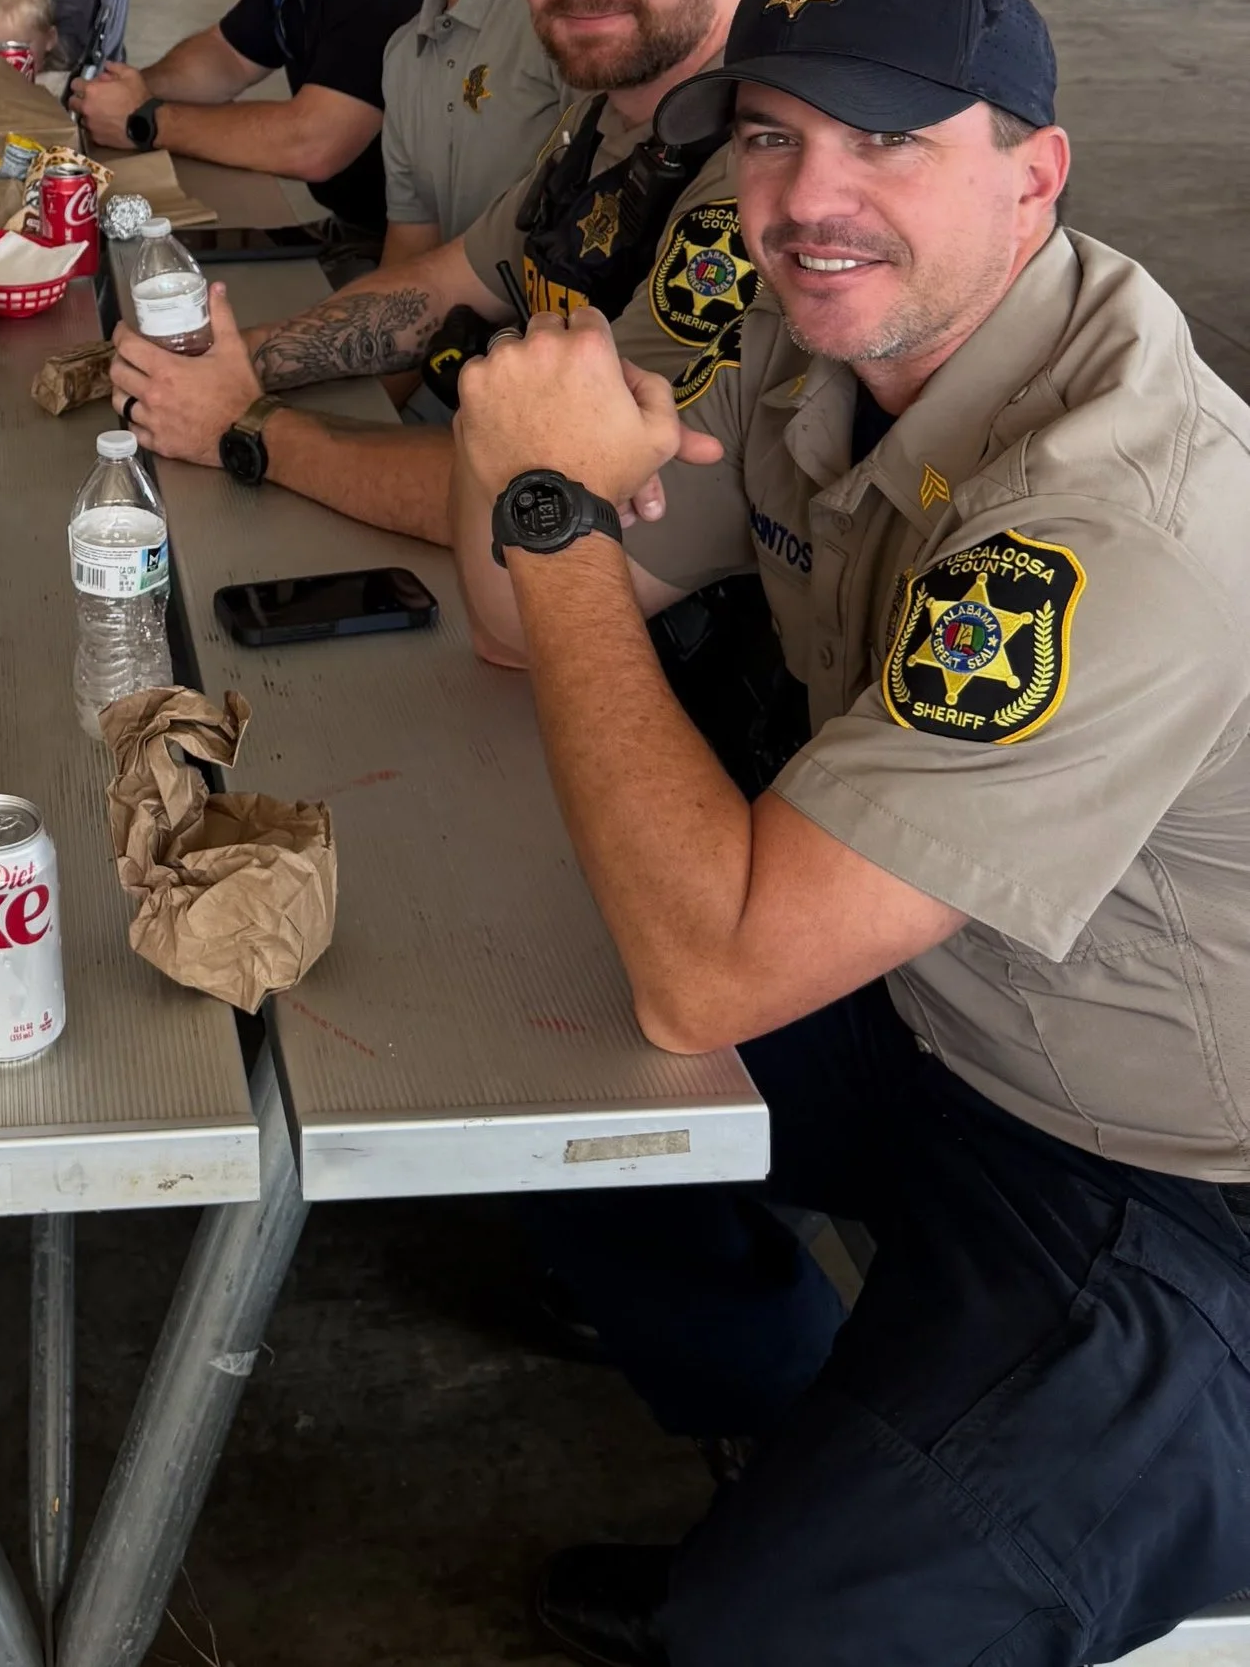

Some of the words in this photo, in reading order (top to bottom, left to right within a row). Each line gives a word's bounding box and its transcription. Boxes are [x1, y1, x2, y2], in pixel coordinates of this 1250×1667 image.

[690, 209, 740, 224] TUSCAL
[702, 220, 740, 233] COUN
[670, 311, 718, 334] SHERIFF
[937, 546, 1056, 585] TUSCALOOSA
[950, 562, 1026, 583] COUNTY
[943, 604, 998, 634] ALABAMA
[932, 638, 962, 669] GREAT
[968, 649, 995, 670] SEAL
[912, 701, 986, 730] SHERIFF
